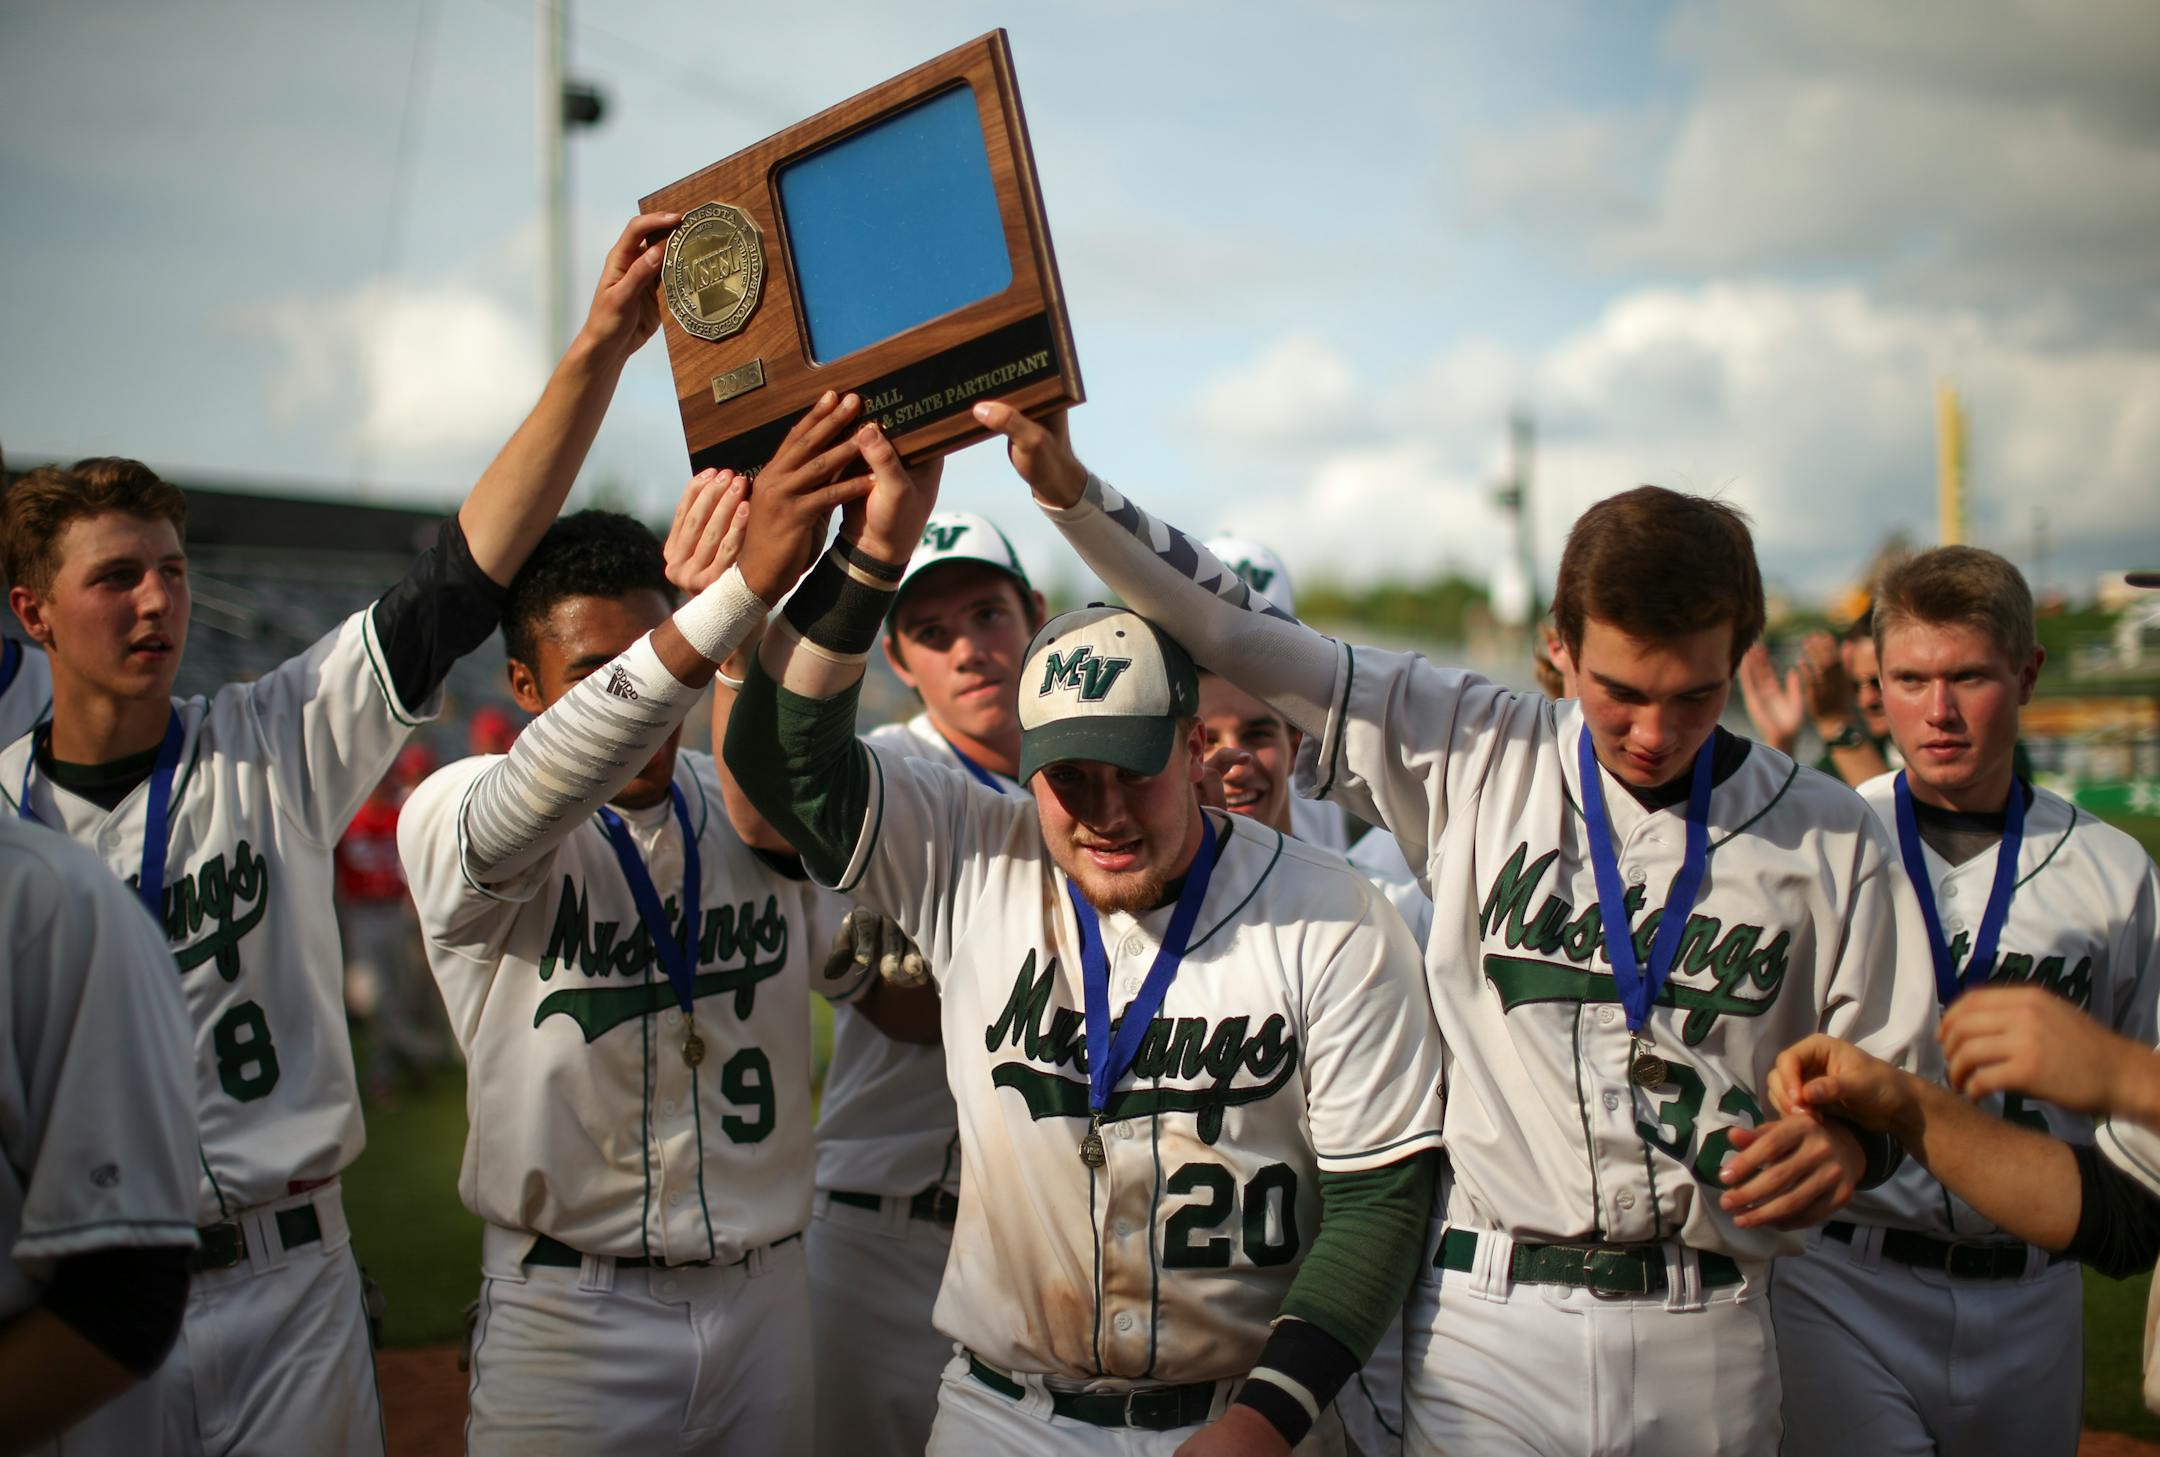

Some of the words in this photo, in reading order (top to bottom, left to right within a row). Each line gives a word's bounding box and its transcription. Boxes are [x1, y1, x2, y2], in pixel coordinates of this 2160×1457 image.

[670, 207, 737, 250] MINNESOTA
[685, 317, 712, 336] HIGH
[713, 301, 750, 335] SCHOOL
[748, 243, 760, 300] LEAGUE
[863, 388, 903, 415] BALL
[882, 414, 894, 429] &
[895, 394, 944, 424] STATE
[946, 351, 1048, 405] PARTICIPANT
[922, 522, 971, 552] V
[615, 663, 639, 700] adidas
[1038, 645, 1132, 703] MV
[214, 1000, 280, 1103] 8
[721, 1047, 776, 1144] 9
[1163, 1162, 1300, 1269] 20
